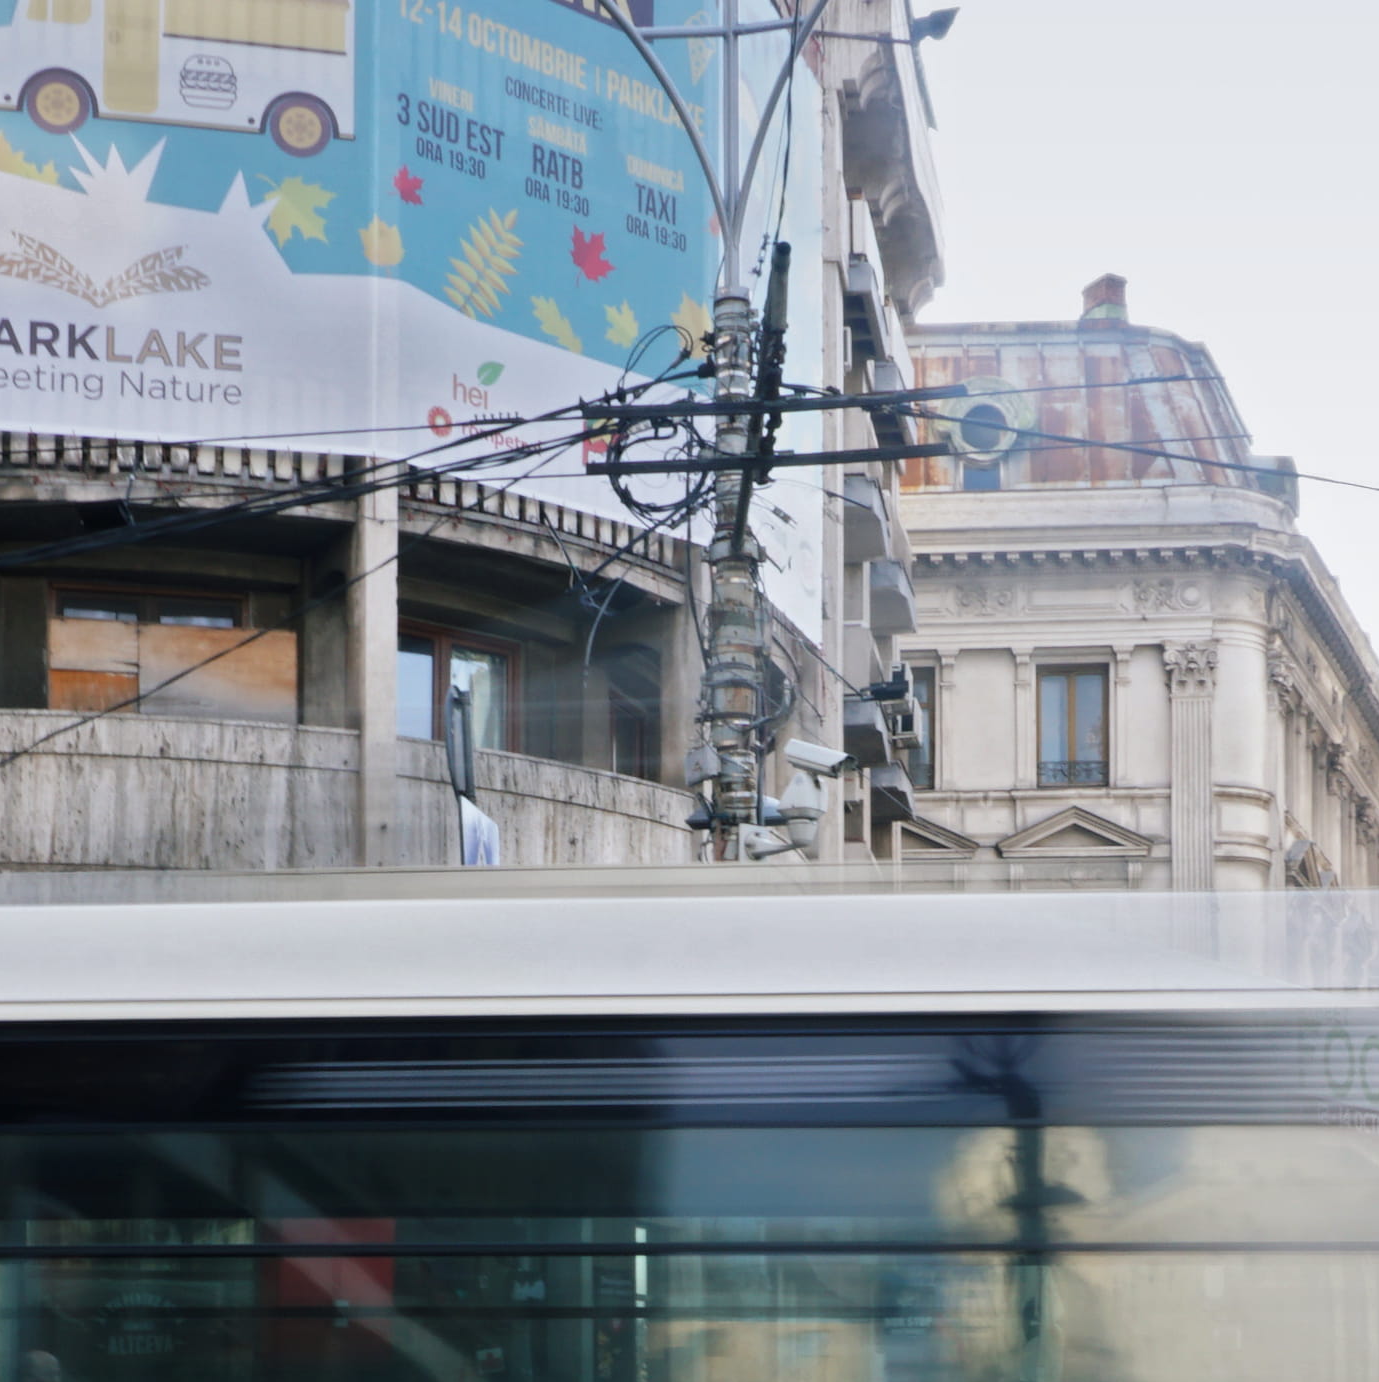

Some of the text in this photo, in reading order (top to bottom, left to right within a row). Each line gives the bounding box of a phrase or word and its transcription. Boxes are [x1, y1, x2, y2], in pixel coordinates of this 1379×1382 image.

[468, 12, 586, 91] OCTOMBRIE
[428, 76, 475, 114] VINERI
[505, 75, 603, 131] CONCERTE LIVE:
[397, 92, 505, 161] 3 SUD EST
[416, 136, 486, 179] ORA 19:30
[532, 142, 583, 190] RATB
[525, 176, 590, 217] ORA 19:30
[635, 181, 677, 226] TAXI
[626, 213, 687, 252] ORA 19:30
[120, 370, 243, 406] Nature
